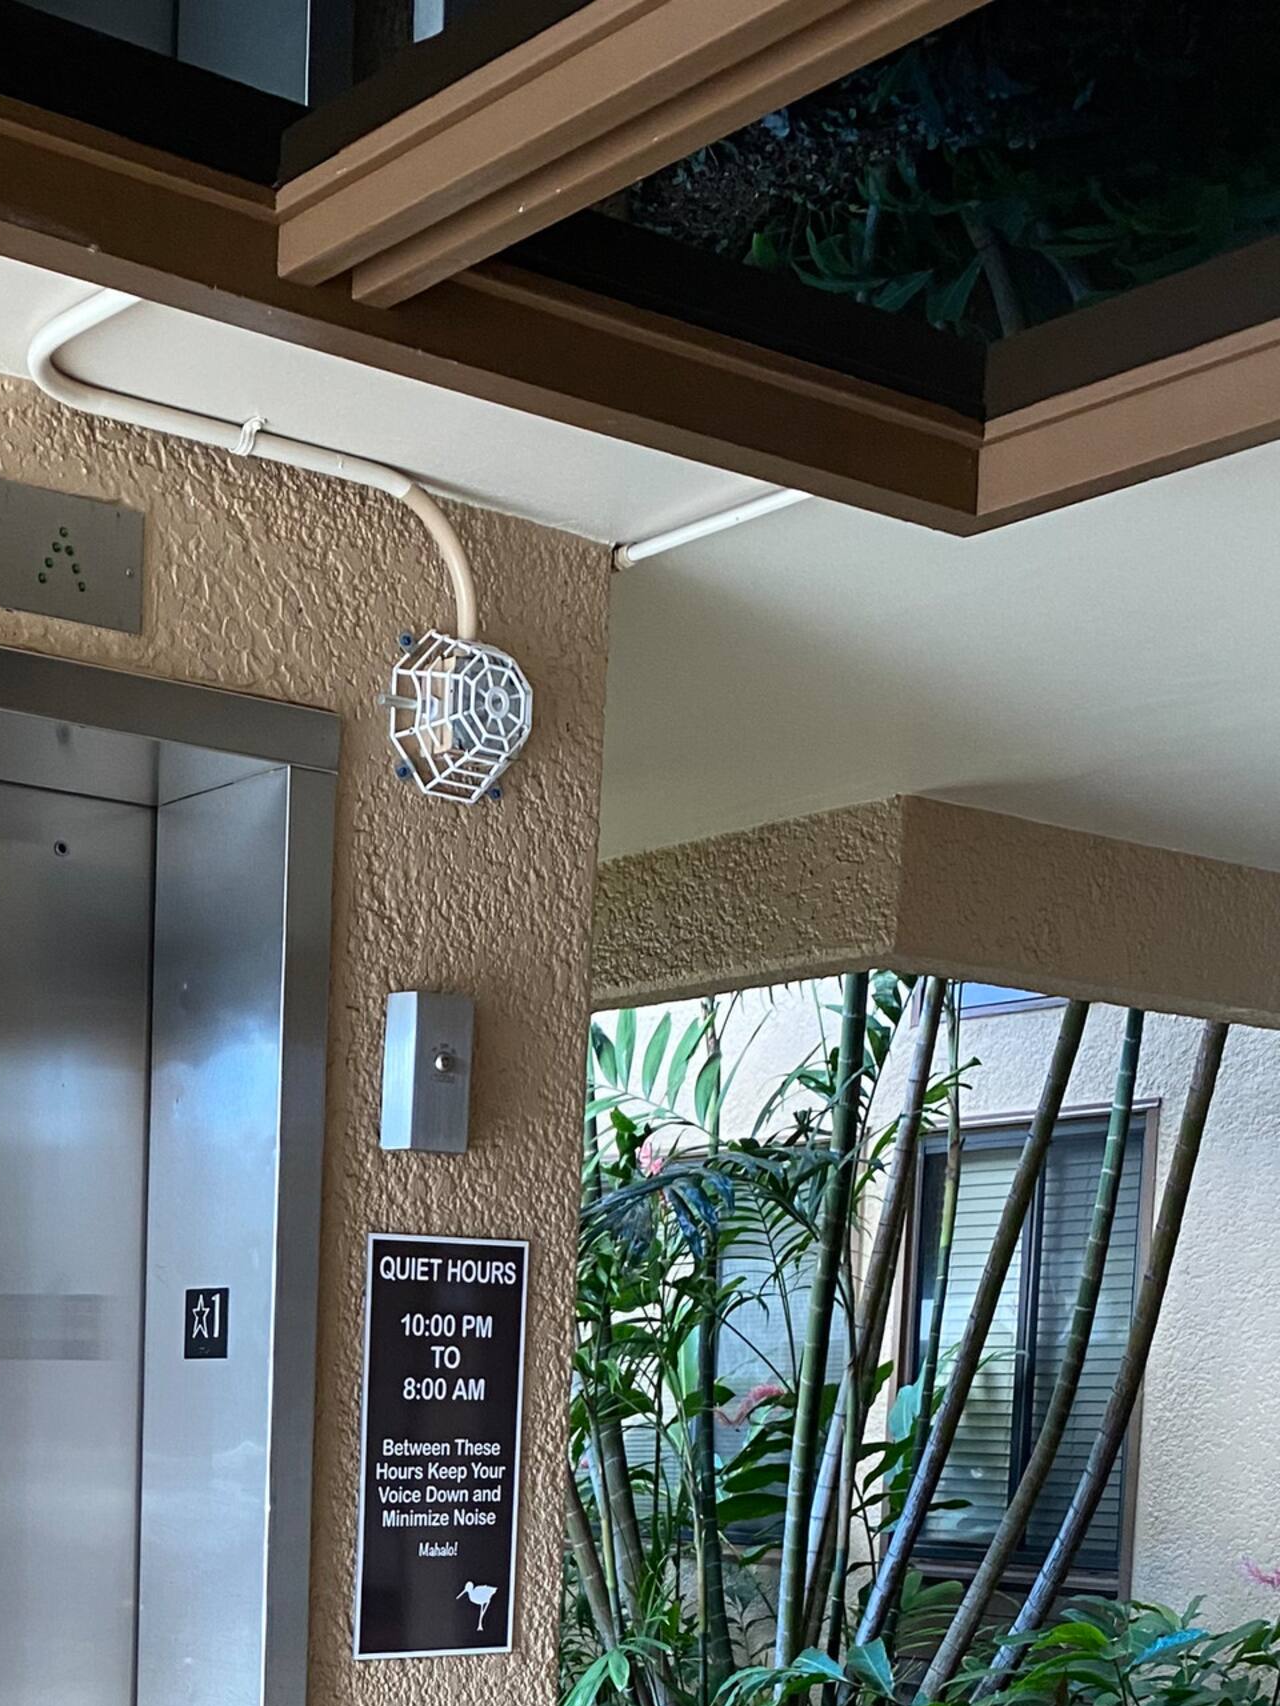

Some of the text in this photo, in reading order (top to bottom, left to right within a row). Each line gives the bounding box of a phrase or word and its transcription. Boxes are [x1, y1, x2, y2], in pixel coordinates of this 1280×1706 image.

[380, 1255, 516, 1285] QUIET HOURS
[211, 1293, 220, 1338] 1
[400, 1313, 493, 1338] 10:00 PM
[430, 1345, 461, 1369] TO
[403, 1377, 486, 1401] 8:00 AM
[382, 1439, 501, 1457] Between These
[376, 1462, 506, 1483] Hours Keep Your
[378, 1485, 502, 1504] Voice Down and
[382, 1508, 496, 1528] Minimize Noise
[418, 1541, 458, 1557] Mahalo!
